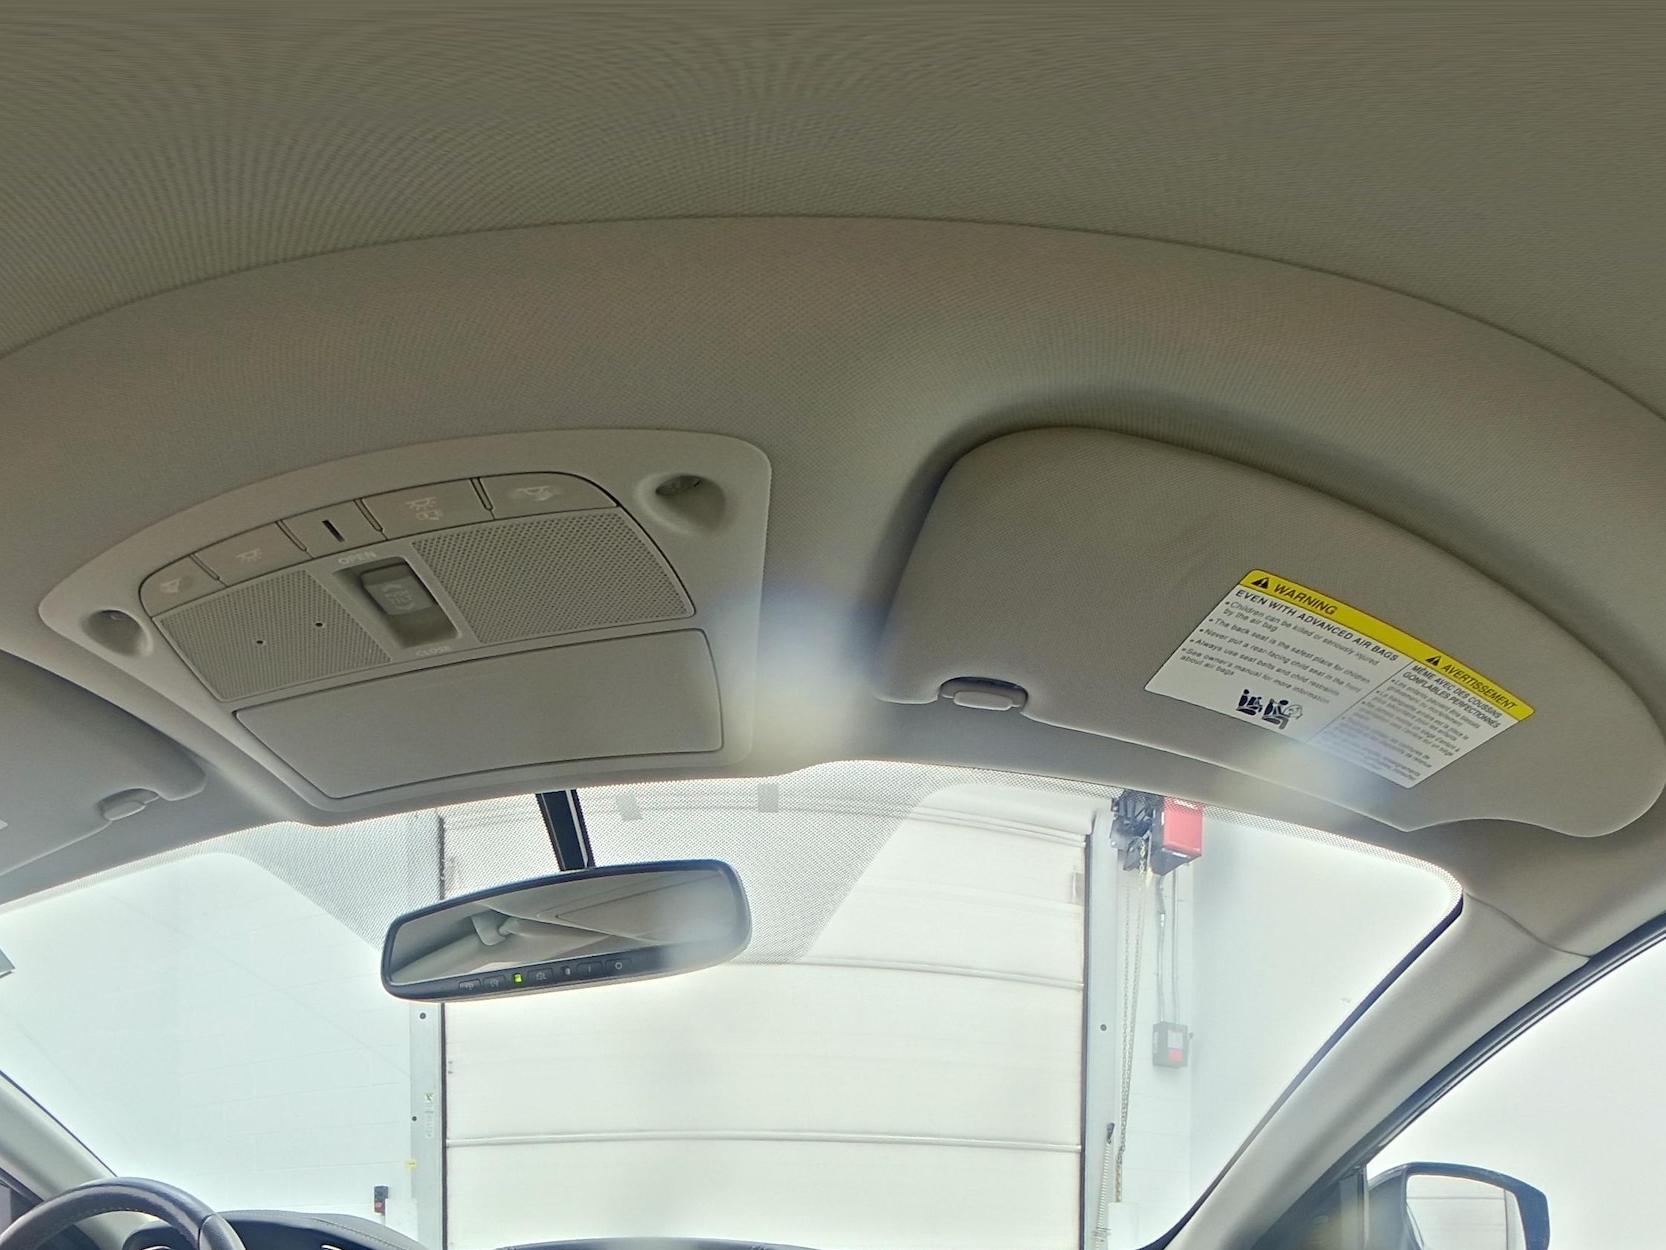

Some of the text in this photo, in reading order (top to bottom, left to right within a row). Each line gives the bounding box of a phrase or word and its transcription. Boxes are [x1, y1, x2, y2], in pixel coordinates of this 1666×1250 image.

[338, 550, 377, 565] OPEN
[1273, 583, 1338, 616] WARNING
[1222, 607, 1279, 633] by the air bag
[1230, 601, 1265, 619] Children
[1264, 611, 1281, 625] can
[1280, 617, 1293, 629] be
[1235, 589, 1400, 662] EVEN WITH ADVANCED AIR BAGS
[1204, 628, 1229, 643] Never
[1213, 617, 1230, 629] The
[1230, 622, 1251, 635] back
[1251, 629, 1269, 643] seat
[415, 646, 452, 657] CLOSE
[1185, 647, 1203, 658] See
[1195, 638, 1223, 653] Always
[1238, 653, 1257, 665] seat
[1402, 671, 1451, 702] GONFLABLES
[1412, 662, 1435, 680] MÊME
[1433, 675, 1455, 691] AVEC
[1454, 687, 1471, 700] DES
[1467, 694, 1504, 720] COUSSINS
[1441, 664, 1518, 711] AVERTISSEMENT
